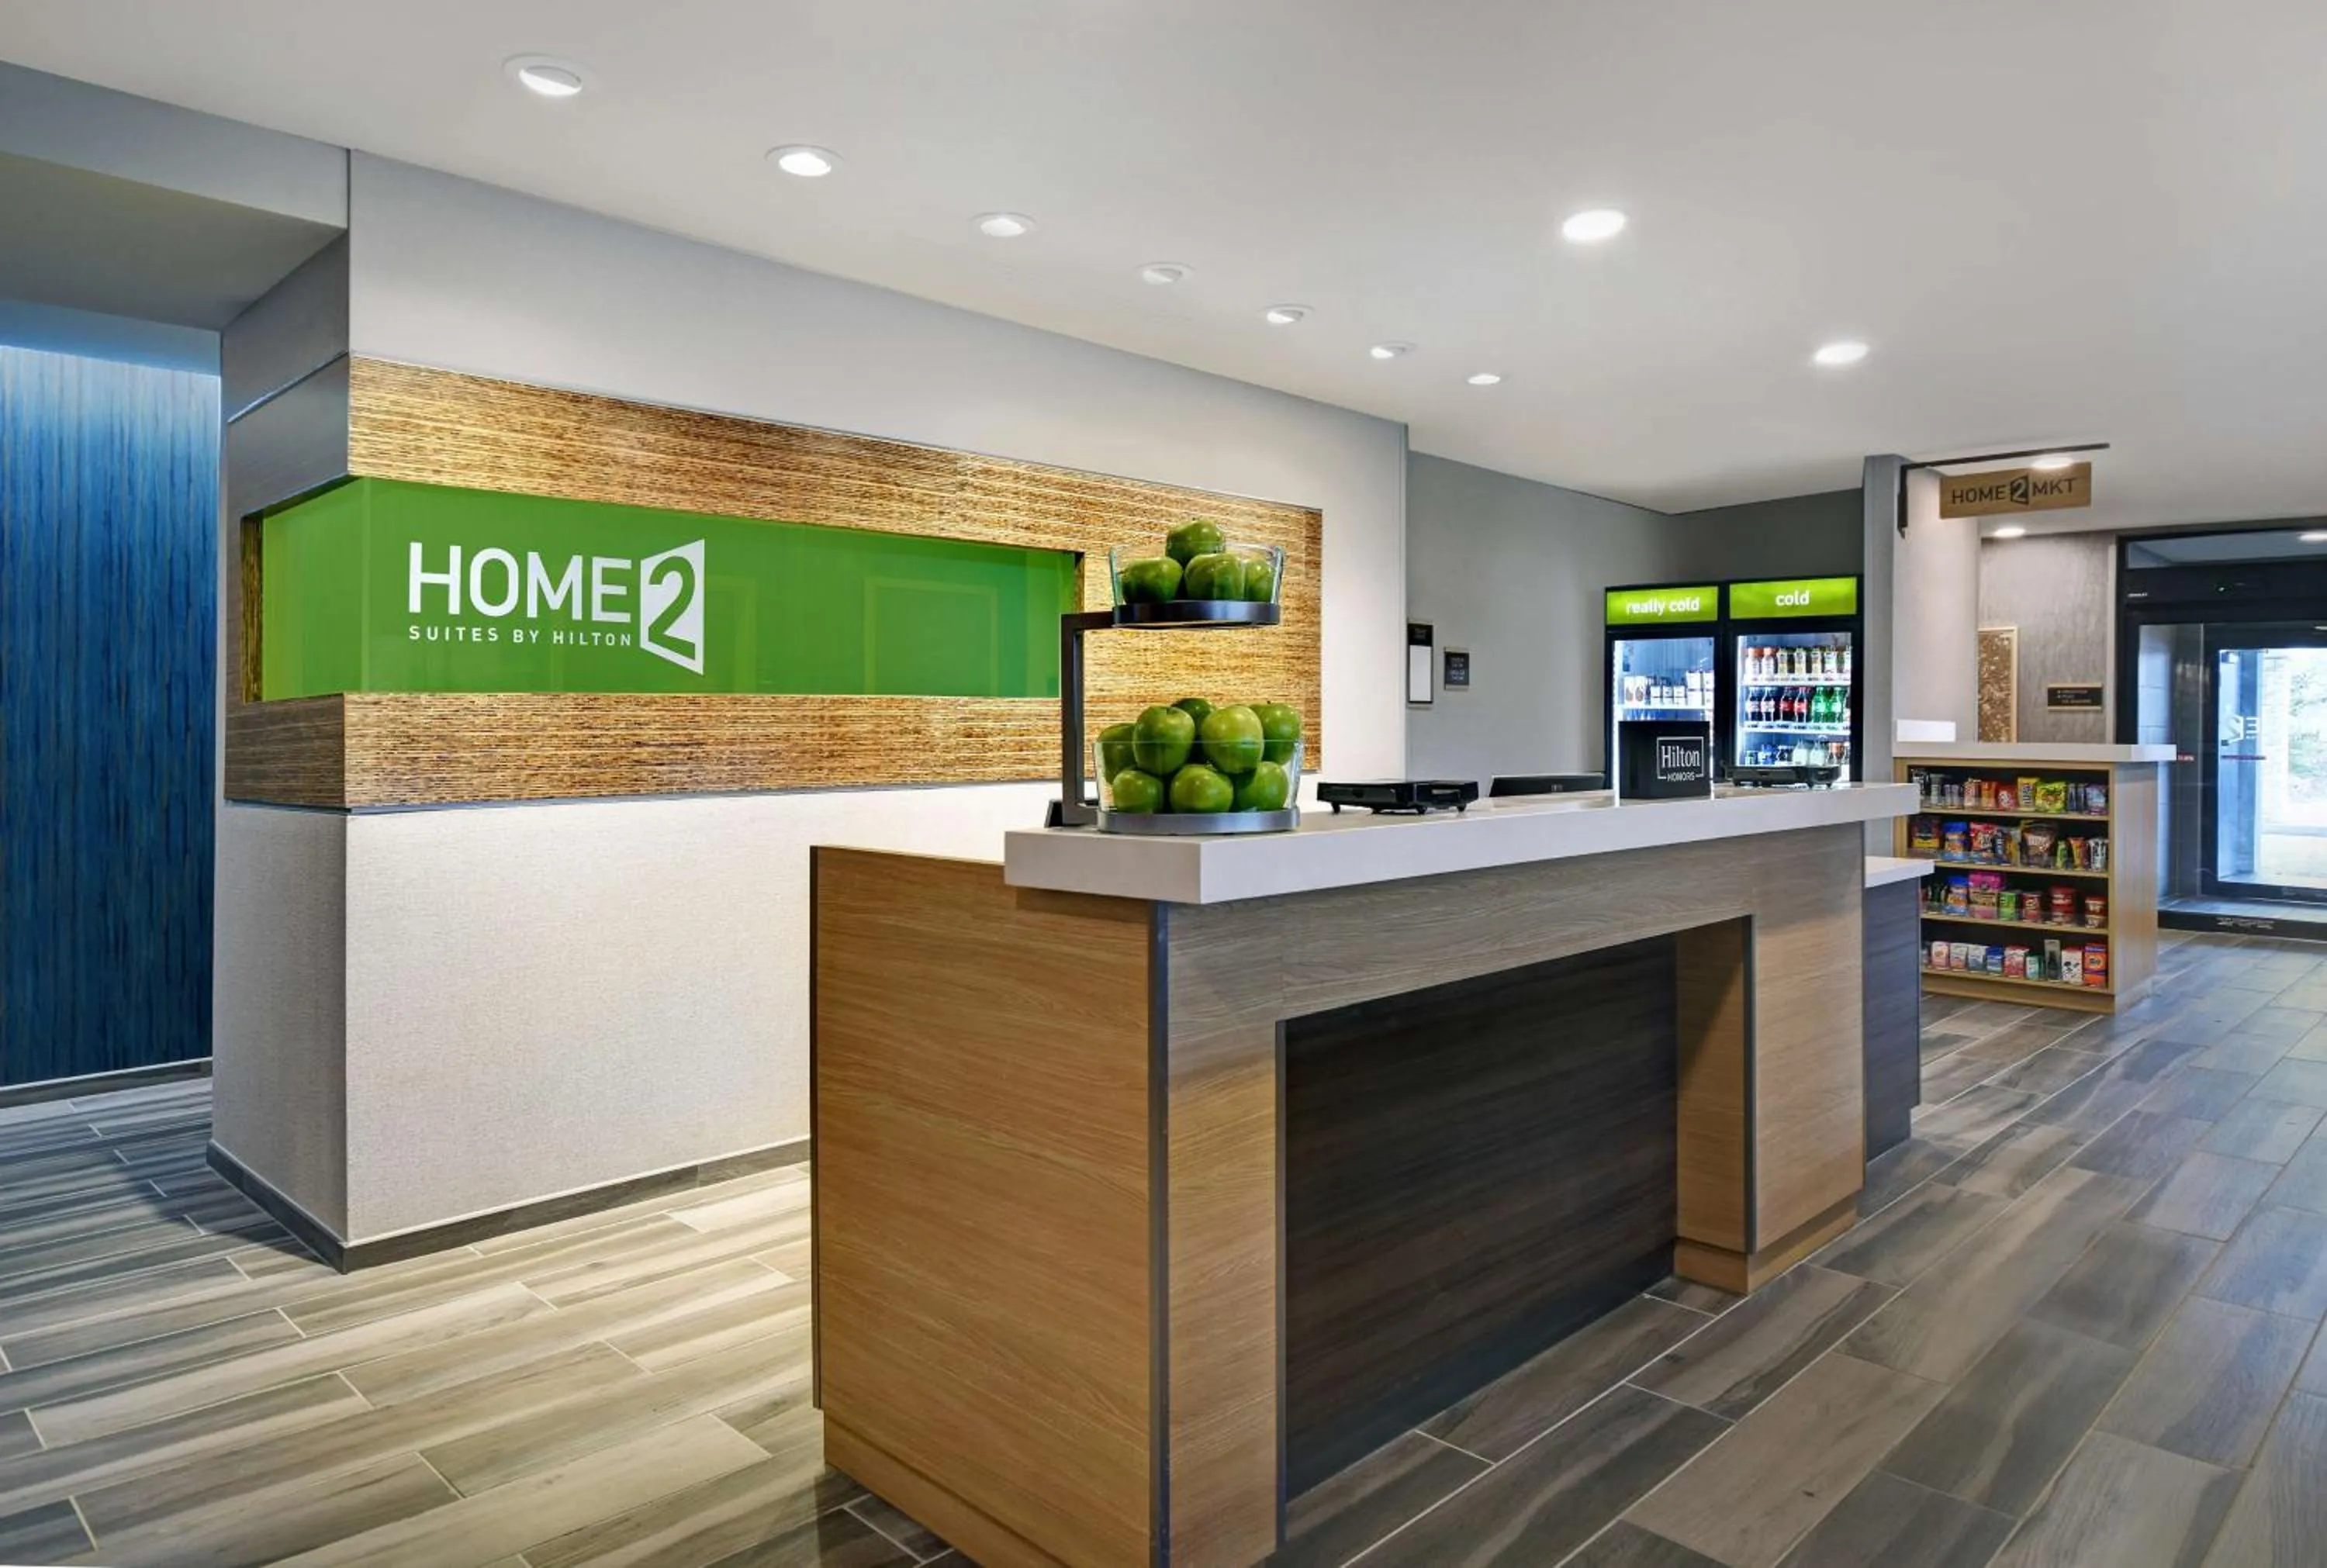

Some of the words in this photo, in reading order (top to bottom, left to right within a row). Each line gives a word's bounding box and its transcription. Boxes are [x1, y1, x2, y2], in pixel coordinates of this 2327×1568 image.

[1952, 483, 2007, 504] HOME
[2032, 477, 2077, 497] MKT
[1626, 596, 1665, 616] really
[1669, 595, 1700, 612] cold
[1775, 589, 1810, 606] cold
[409, 625, 499, 642] SUITES
[512, 629, 540, 643] BY
[552, 630, 631, 646] HILTON
[1661, 745, 1701, 768] Hilton
